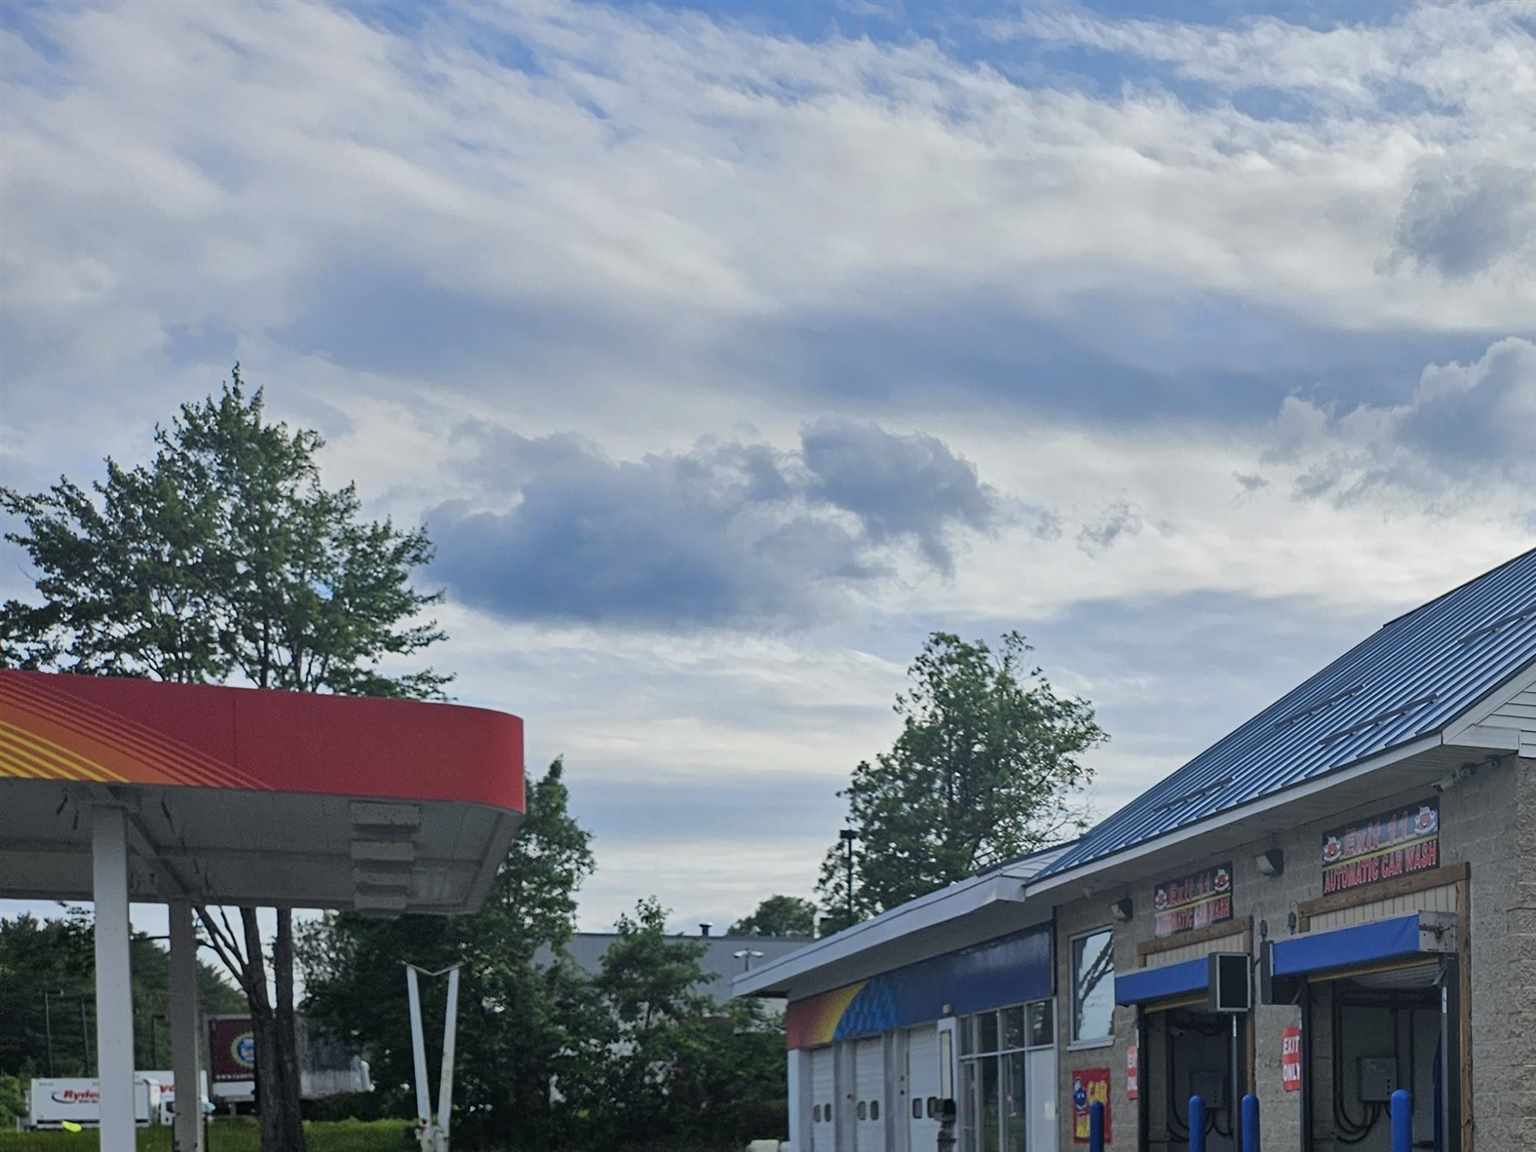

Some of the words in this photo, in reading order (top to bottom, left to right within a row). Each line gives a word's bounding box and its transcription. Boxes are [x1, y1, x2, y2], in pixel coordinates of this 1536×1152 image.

[1324, 857, 1379, 894] AUTOMATIC
[1380, 850, 1402, 879] CAR
[1404, 838, 1437, 873] WASH
[1282, 1035, 1300, 1056] EXIT
